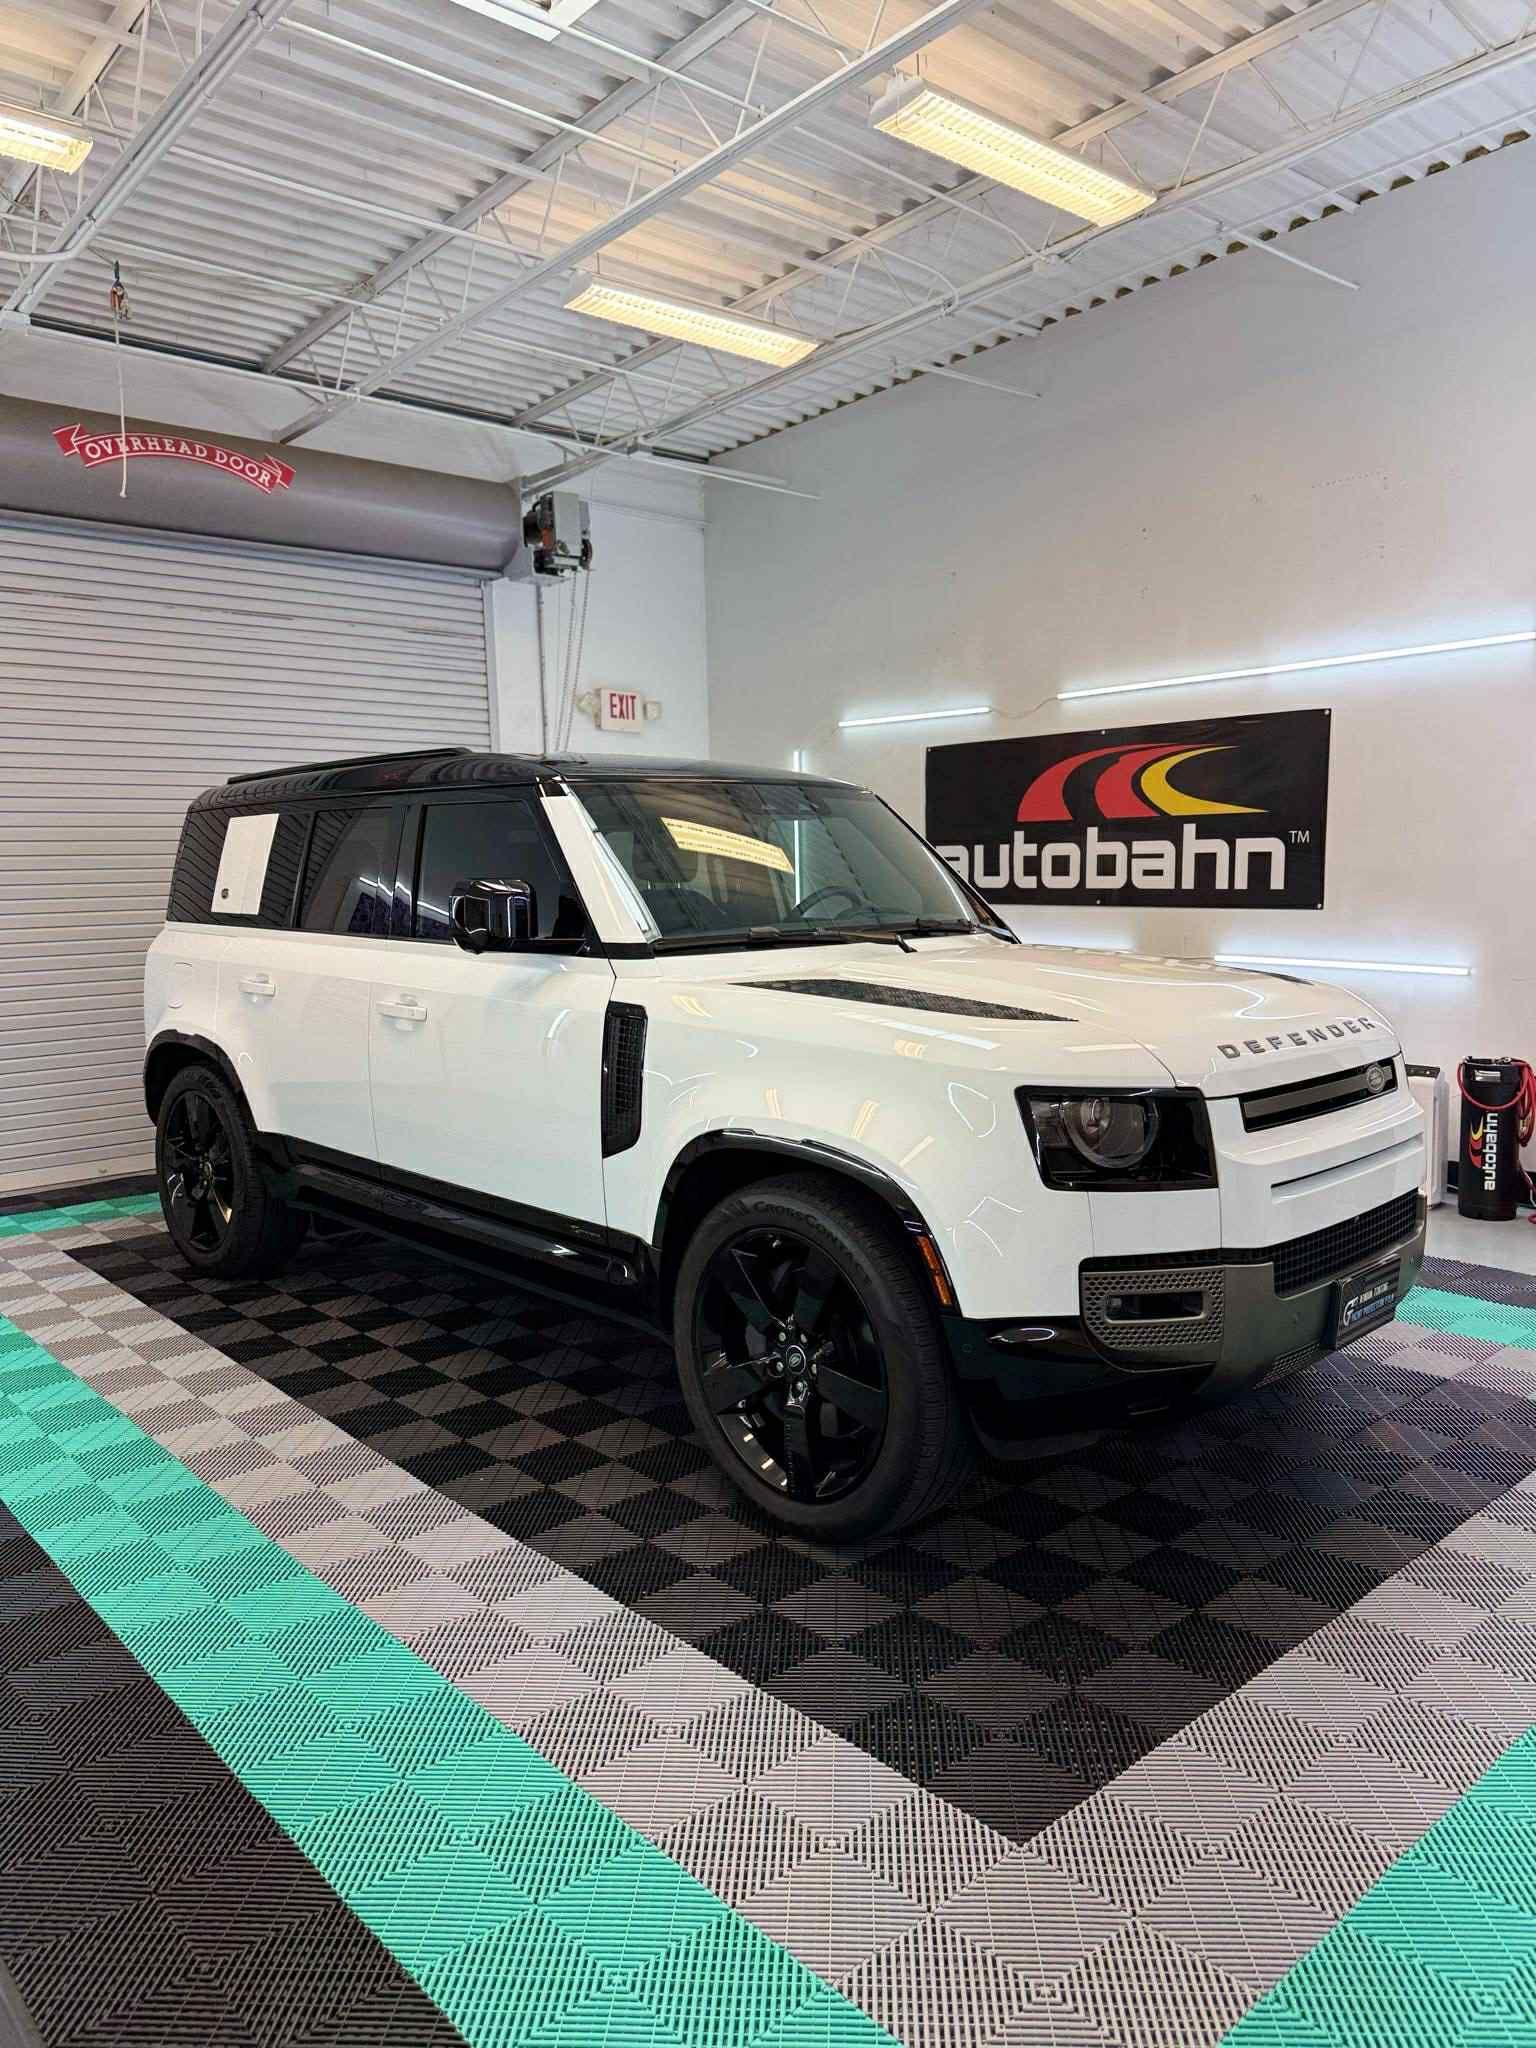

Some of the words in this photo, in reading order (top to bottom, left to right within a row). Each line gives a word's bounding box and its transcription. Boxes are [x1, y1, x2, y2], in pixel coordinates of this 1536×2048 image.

[85, 436, 208, 459] OVERHEAD
[215, 451, 271, 487] DOOR
[609, 693, 637, 720] EXIT
[1217, 1017, 1376, 1059] DEFENDER
[1482, 1112, 1499, 1191] autobahn
